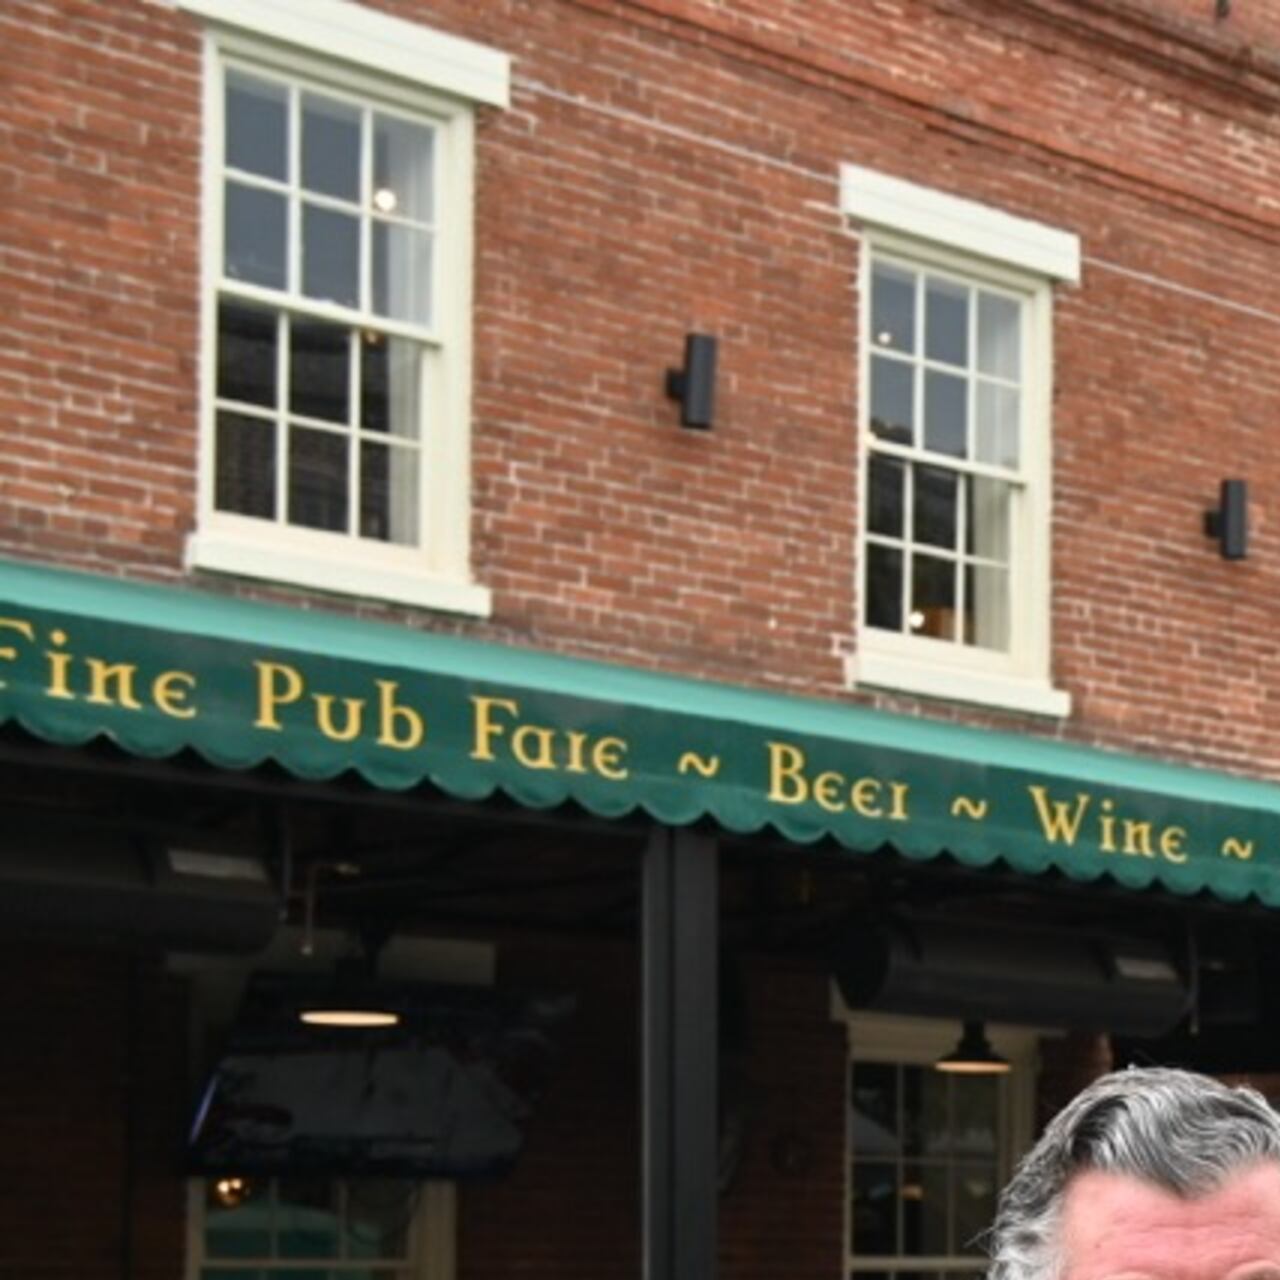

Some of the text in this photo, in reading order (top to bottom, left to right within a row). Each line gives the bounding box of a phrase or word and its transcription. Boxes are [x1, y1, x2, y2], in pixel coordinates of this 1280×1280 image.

[254, 661, 424, 750] Pub
[470, 695, 628, 780] Fare
[766, 742, 909, 820] Beer
[1028, 785, 1188, 864] Wine
